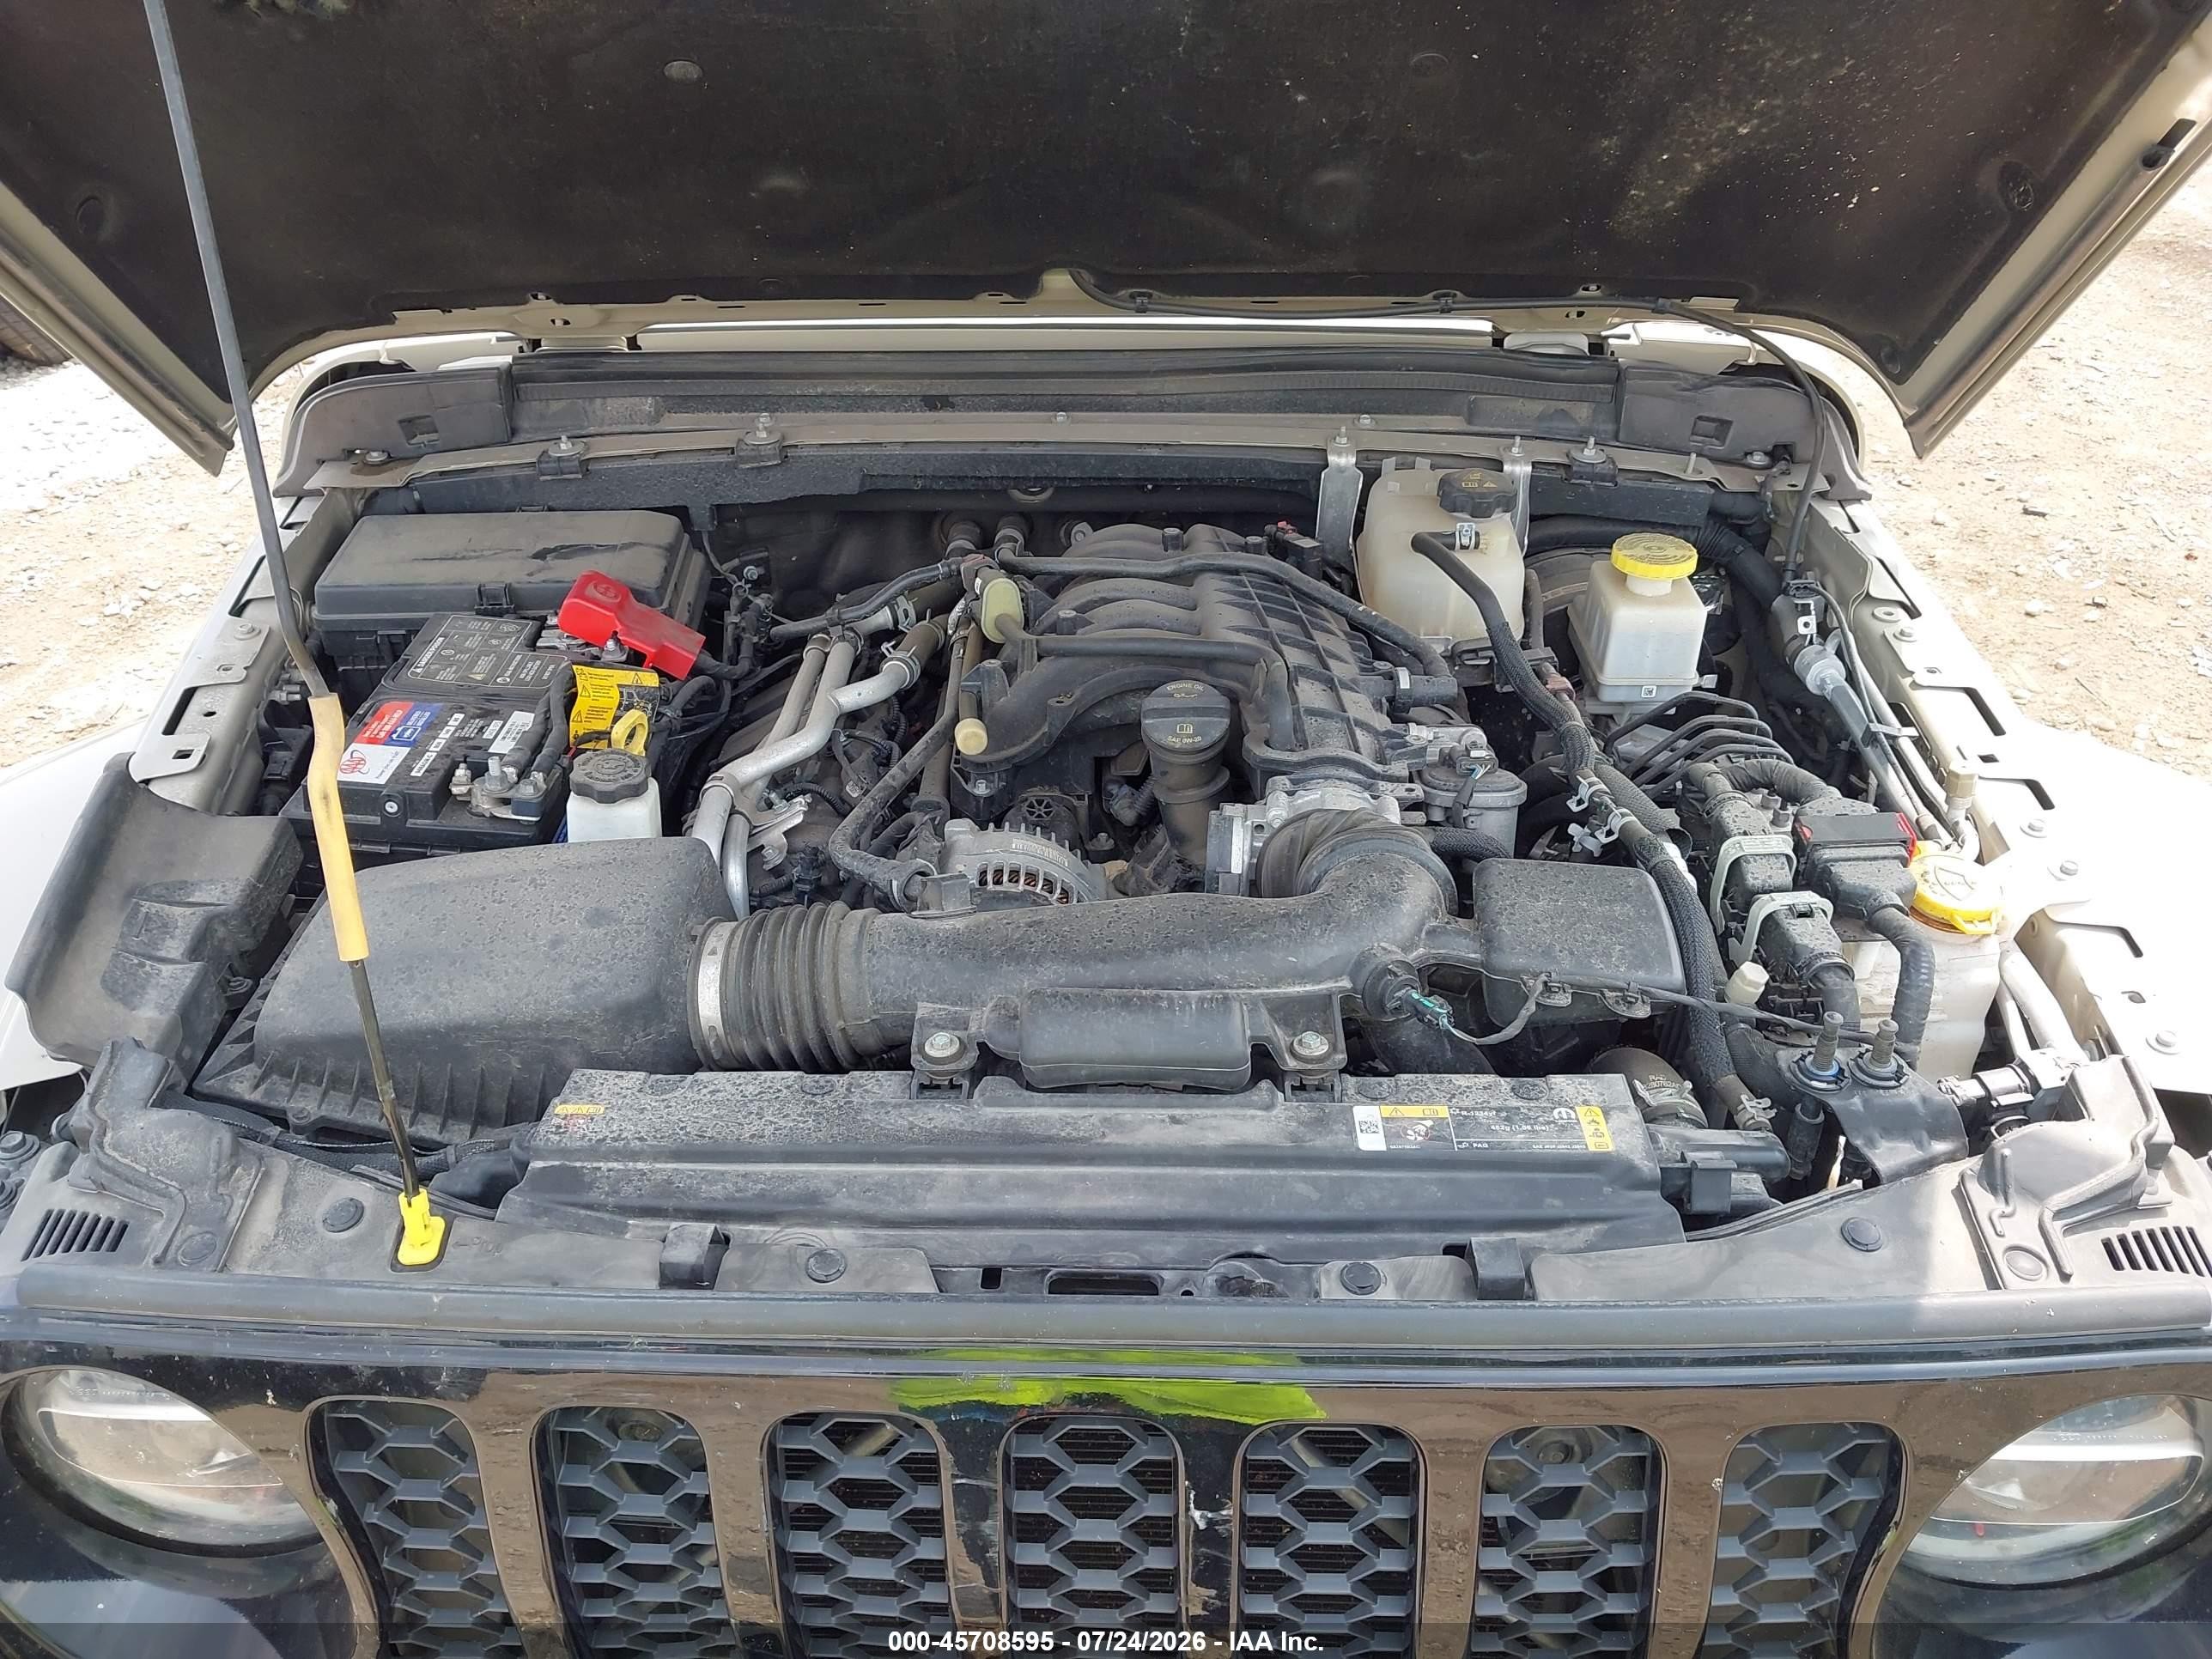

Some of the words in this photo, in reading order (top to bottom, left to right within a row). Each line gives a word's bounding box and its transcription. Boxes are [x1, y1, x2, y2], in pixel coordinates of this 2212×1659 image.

[1167, 683, 1194, 691] ENGINE
[1194, 684, 1204, 692] OIL
[340, 753, 367, 775] AAA
